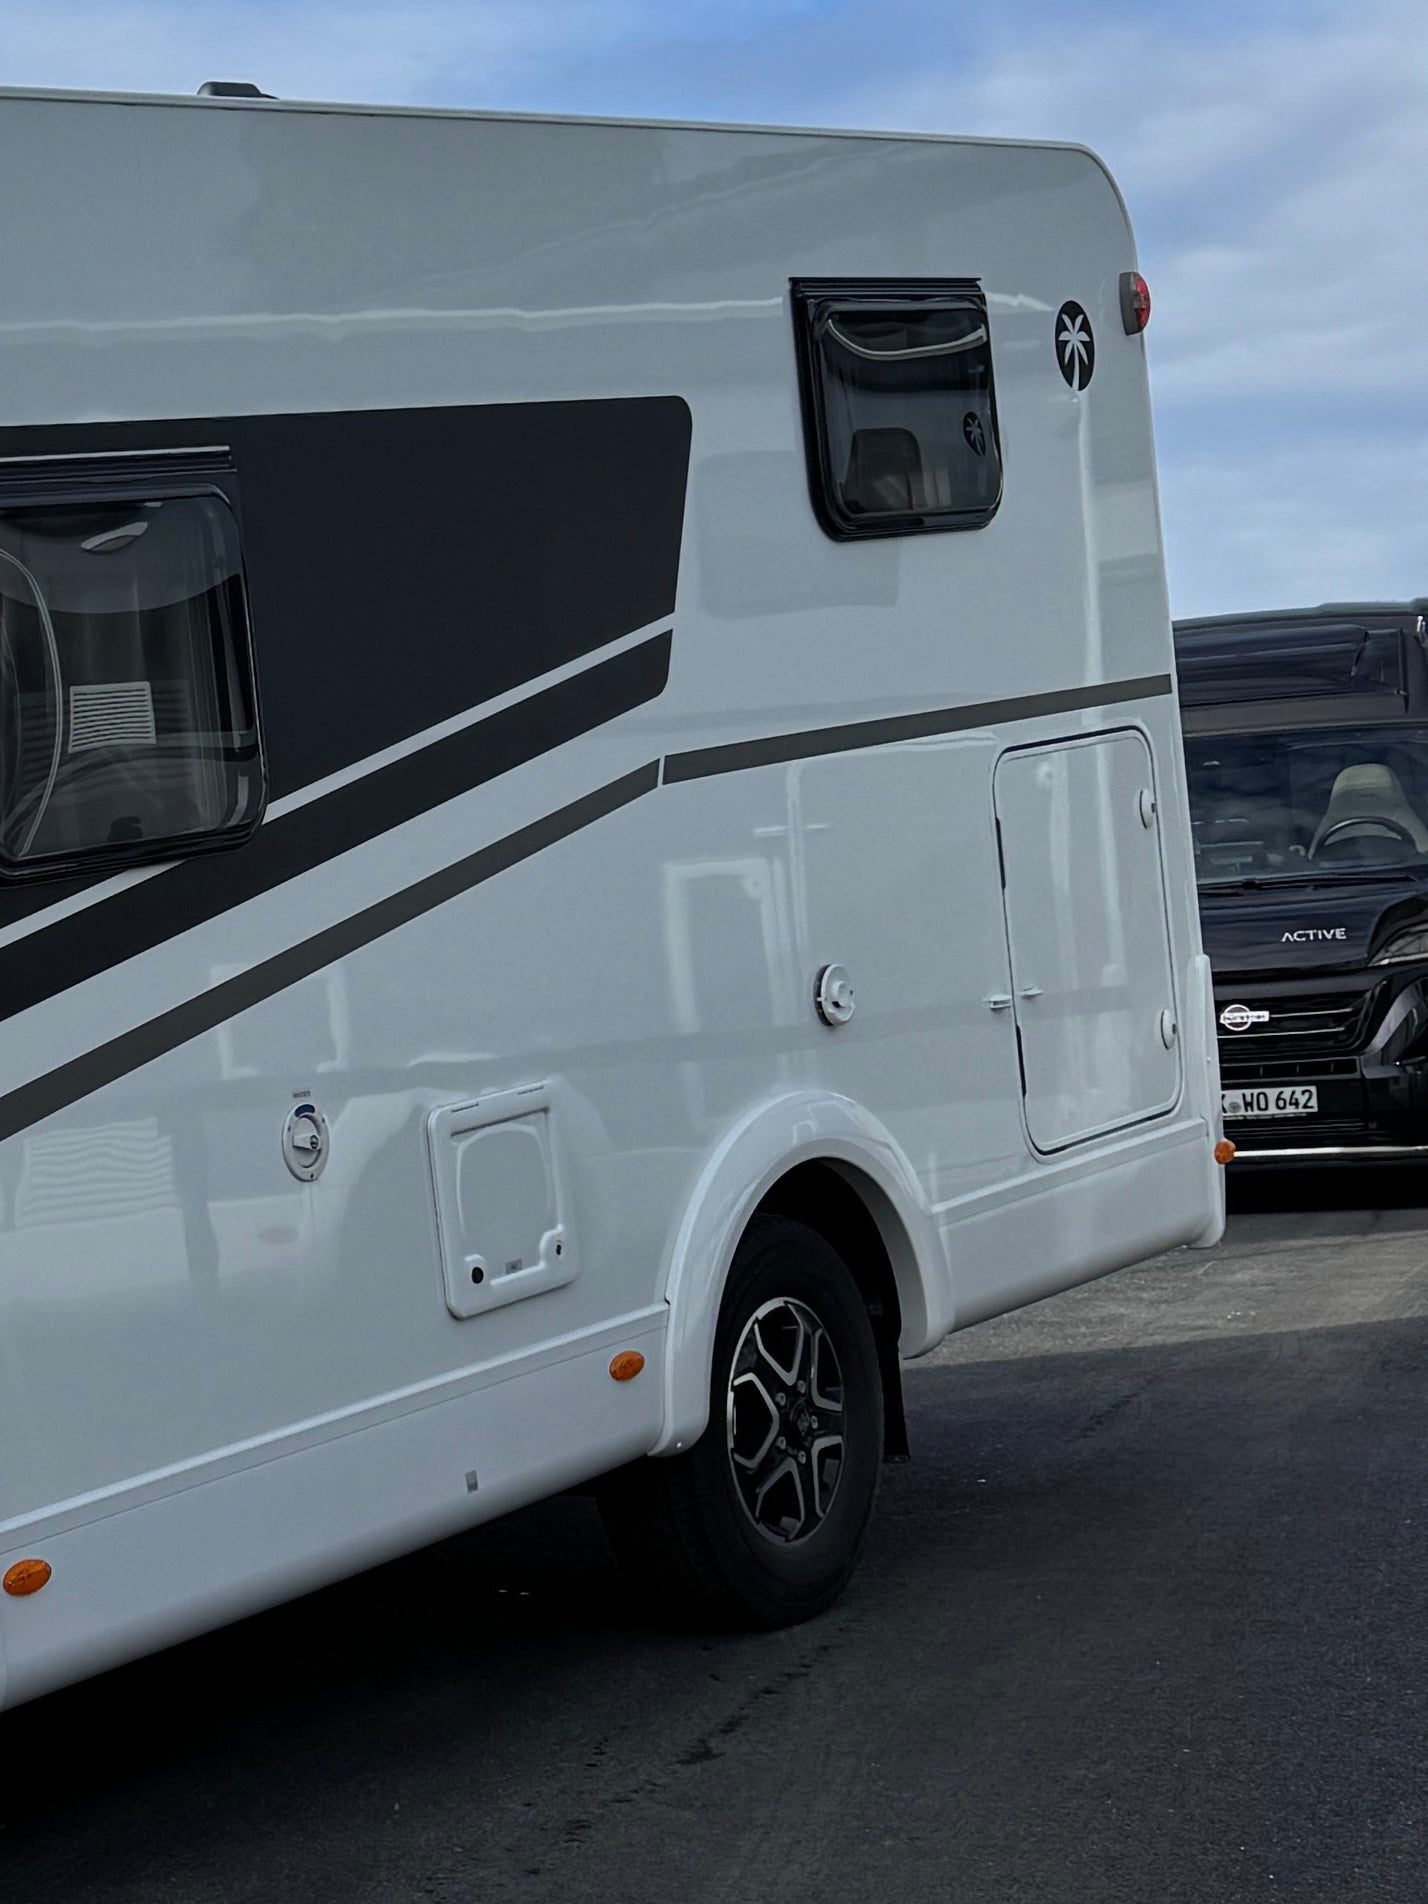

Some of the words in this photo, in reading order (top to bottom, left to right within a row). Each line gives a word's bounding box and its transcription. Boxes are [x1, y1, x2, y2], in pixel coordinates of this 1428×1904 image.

[1281, 927, 1347, 942] ACTIVE
[1242, 1091, 1269, 1113] WO
[1275, 1089, 1314, 1110] 642
